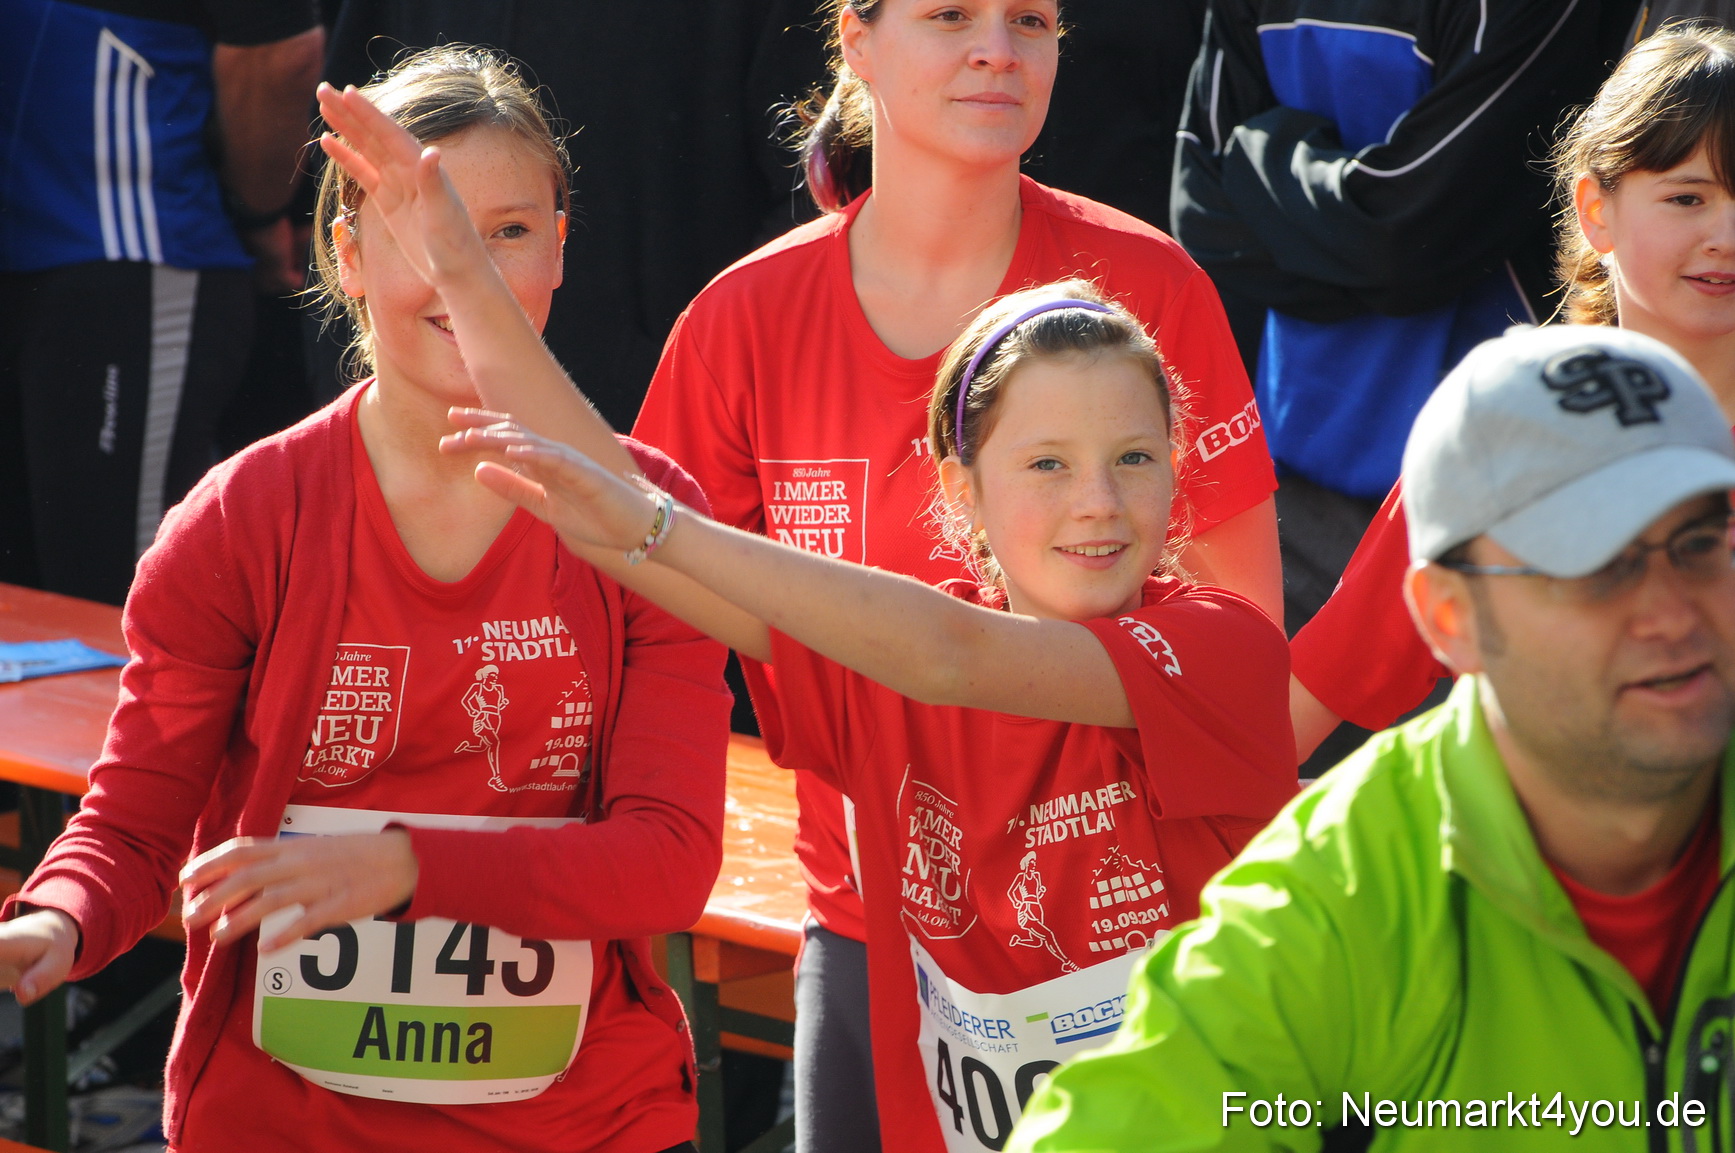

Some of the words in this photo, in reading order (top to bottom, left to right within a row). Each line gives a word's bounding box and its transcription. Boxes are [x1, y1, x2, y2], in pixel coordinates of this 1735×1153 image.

[1541, 345, 1671, 427] SP
[806, 467, 831, 478] Jahre
[773, 480, 847, 501] IMMER
[768, 504, 852, 525] WIEDER
[775, 528, 845, 558] NEU
[340, 651, 371, 662] Jahre
[327, 665, 390, 687] MER
[321, 690, 392, 712] EDER
[271, 972, 284, 991] S
[352, 1006, 493, 1064] Anna
